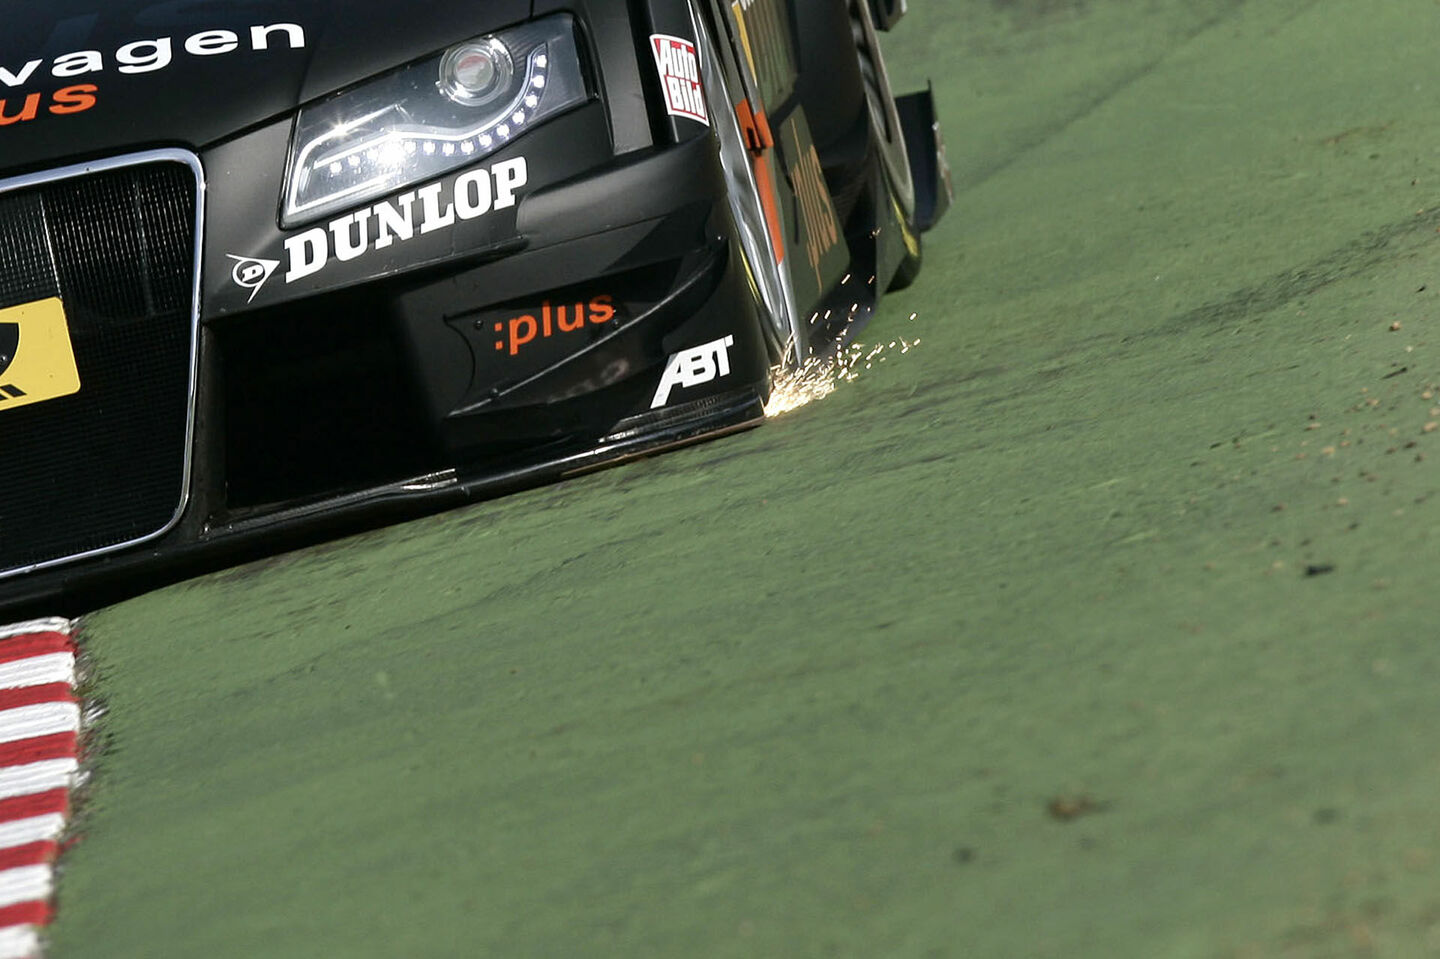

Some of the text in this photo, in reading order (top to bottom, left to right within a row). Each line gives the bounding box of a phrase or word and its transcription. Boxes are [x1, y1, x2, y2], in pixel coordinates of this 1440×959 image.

[659, 38, 698, 84] Auto
[666, 75, 705, 116] Bild
[285, 156, 528, 284] DUNLOP
[494, 293, 615, 356] :plus
[650, 334, 733, 408] ABT
